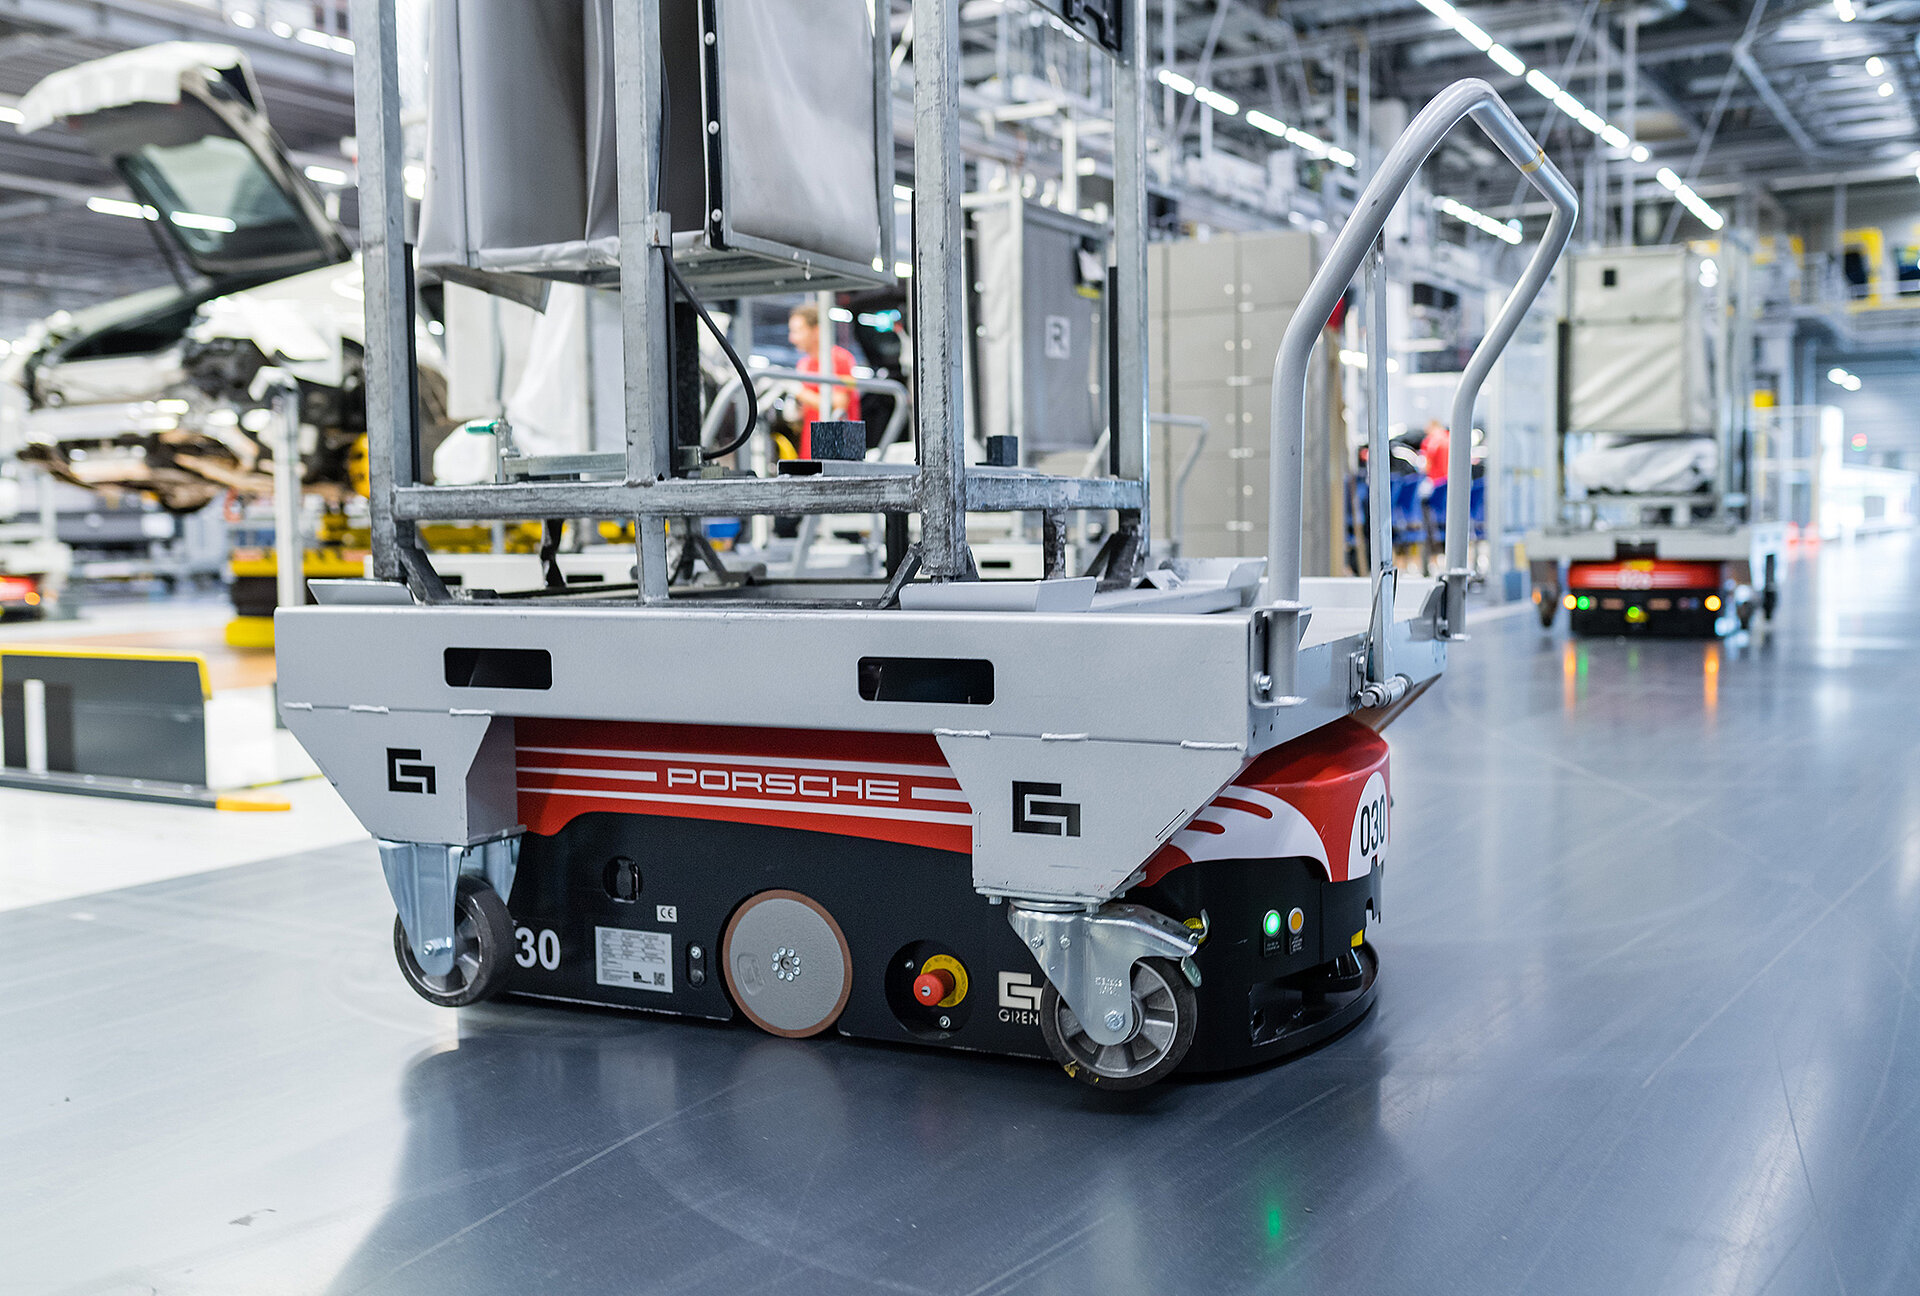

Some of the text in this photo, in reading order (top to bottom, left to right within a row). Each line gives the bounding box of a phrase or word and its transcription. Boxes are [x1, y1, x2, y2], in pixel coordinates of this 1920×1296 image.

[667, 767, 900, 802] PORSCHE
[1361, 794, 1386, 857] 030
[515, 926, 561, 971] 30
[998, 1009, 1039, 1026] GREN
